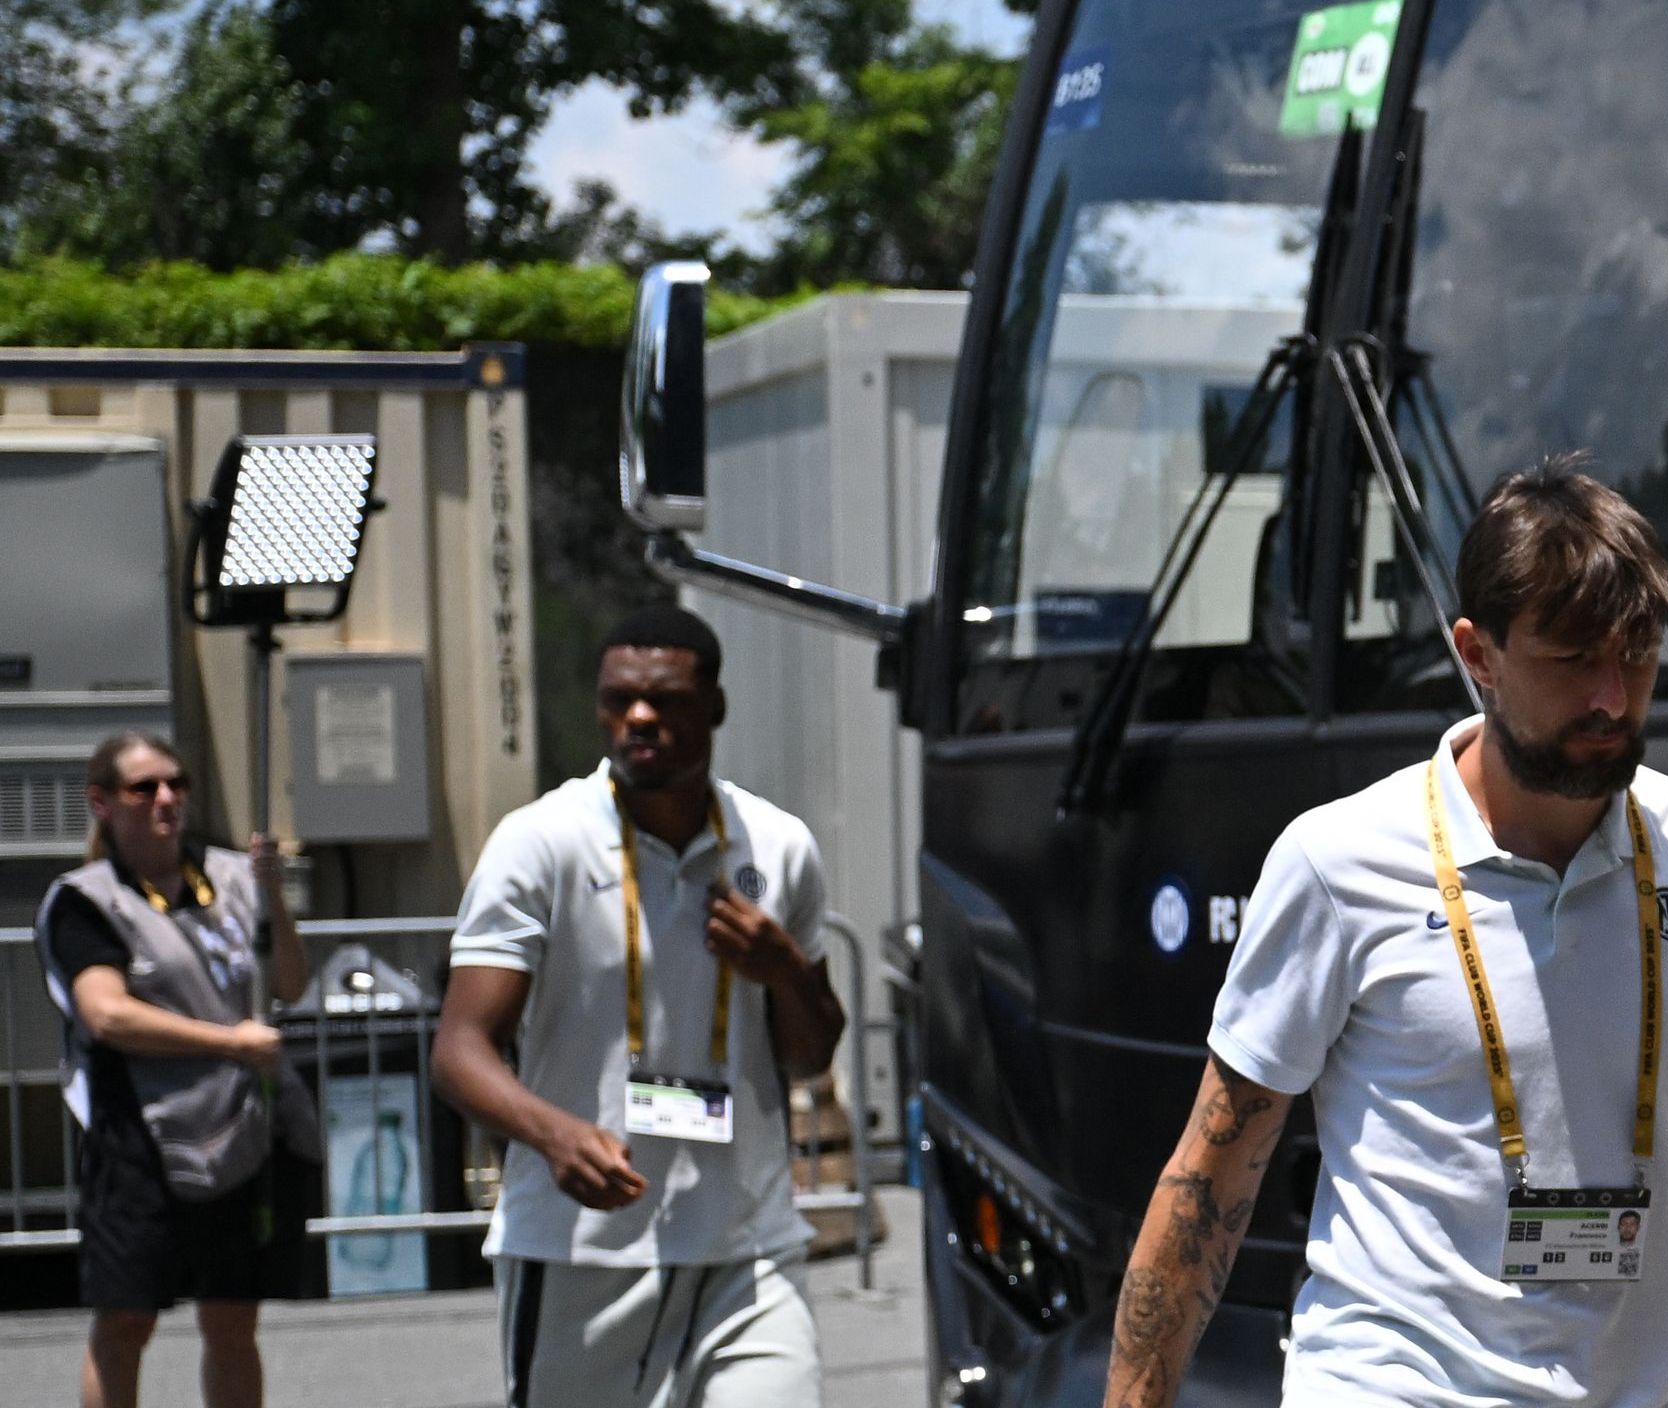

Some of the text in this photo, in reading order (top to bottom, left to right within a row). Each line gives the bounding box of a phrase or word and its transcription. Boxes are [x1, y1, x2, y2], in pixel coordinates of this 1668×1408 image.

[1646, 957, 1656, 978] CUP
[1458, 928, 1471, 952] FIFA
[1465, 952, 1480, 981] CLUB
[1473, 982, 1492, 1023] WORLD
[1484, 1022, 1497, 1046] CUP
[1647, 980, 1656, 1019] WORLD
[1645, 1021, 1656, 1049] CLUB
[1644, 1051, 1654, 1075] FIFA
